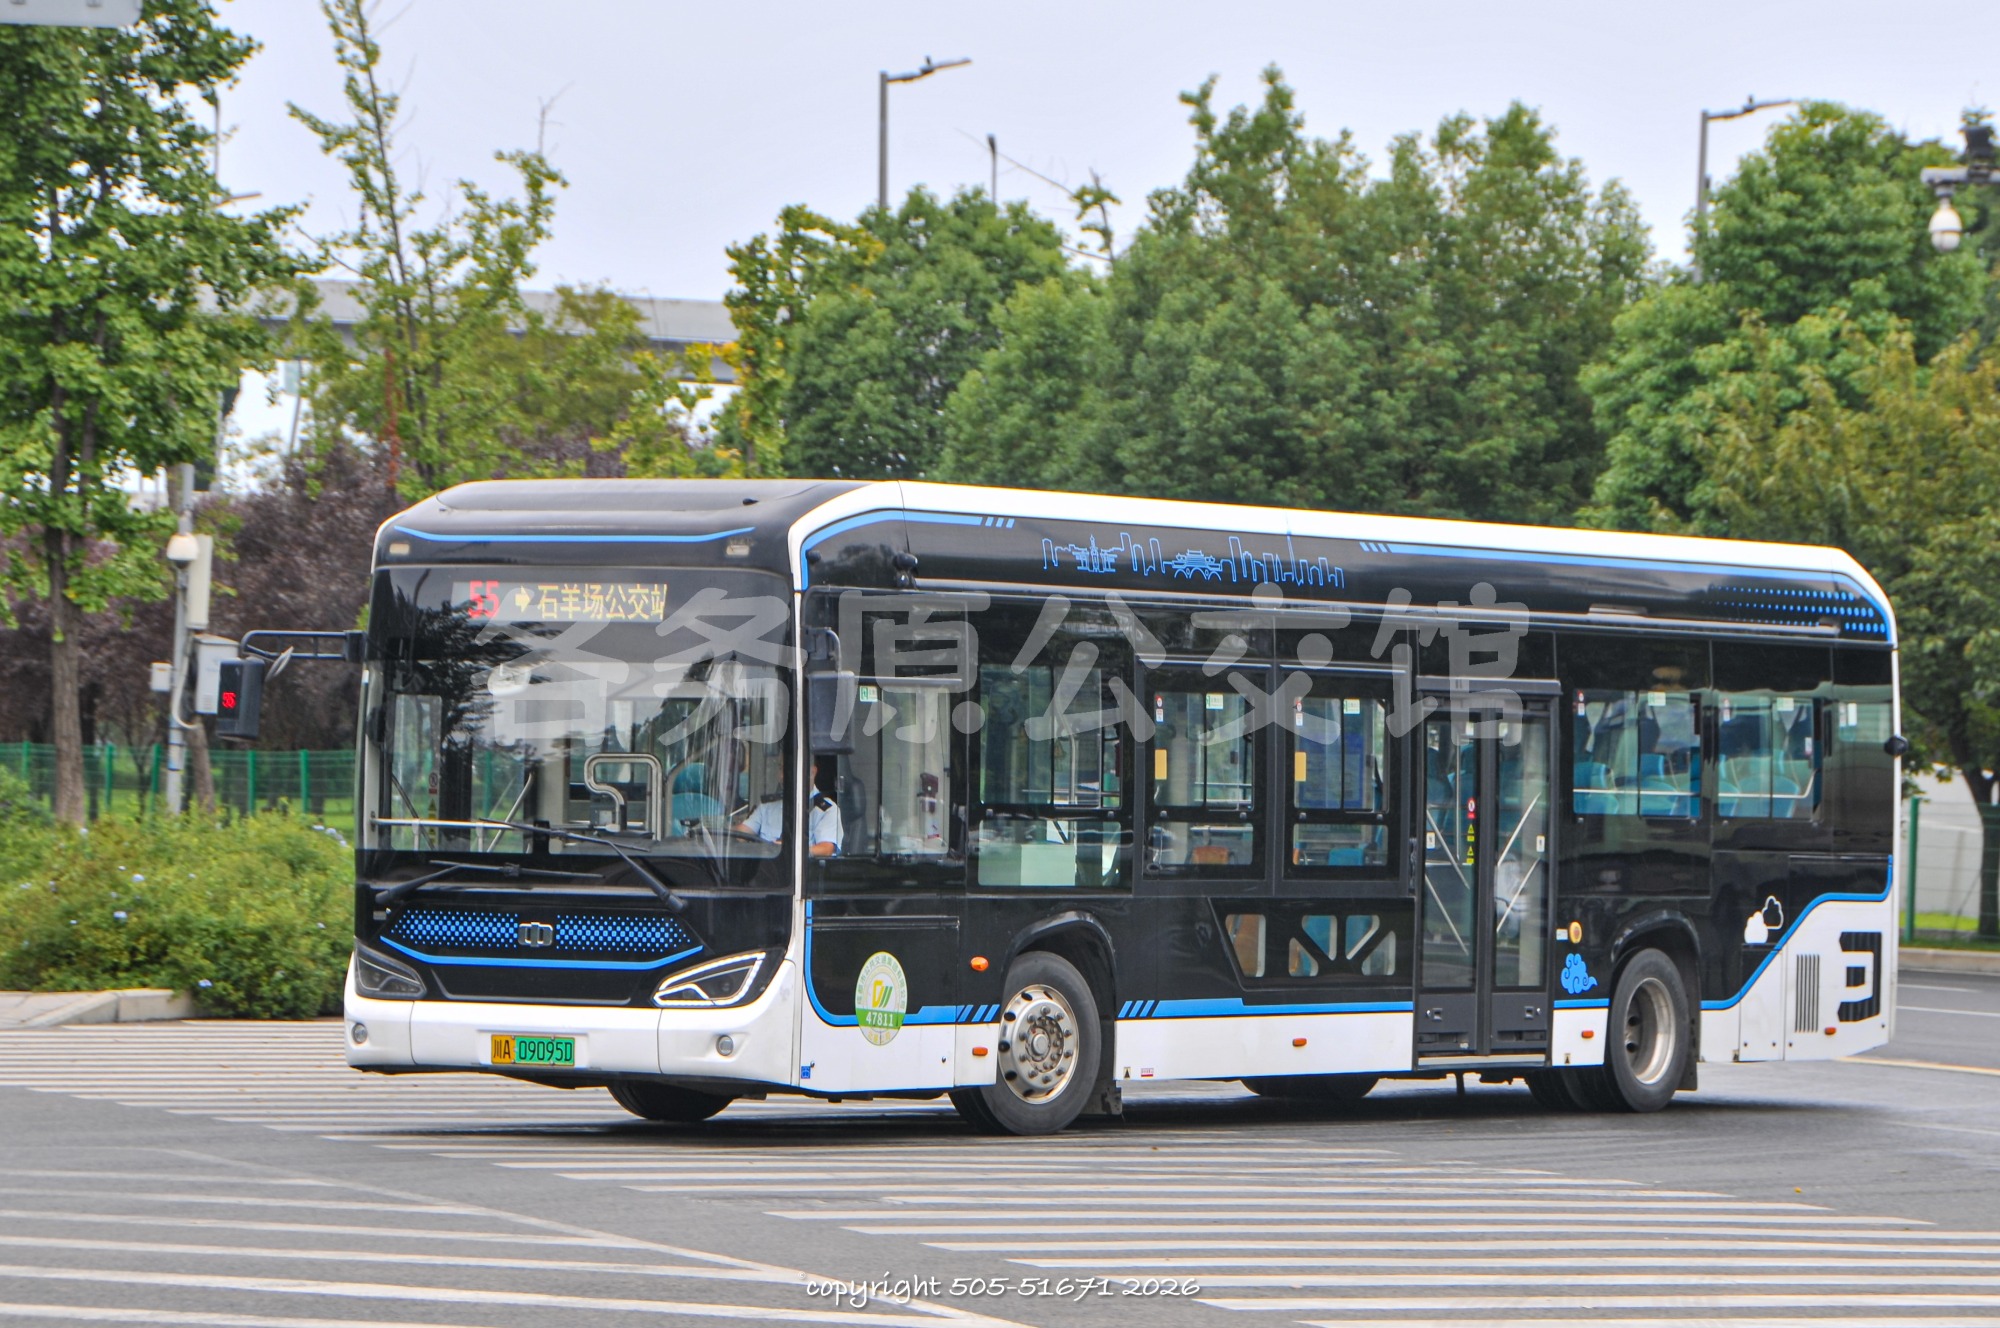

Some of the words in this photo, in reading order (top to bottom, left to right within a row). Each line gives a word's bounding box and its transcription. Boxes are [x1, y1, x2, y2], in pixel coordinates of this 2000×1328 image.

[467, 579, 500, 620] 55
[537, 583, 668, 620] 石羊场公交站
[865, 1011, 894, 1027] 47811
[493, 1039, 511, 1059] 川A
[518, 1040, 573, 1062] 09095D
